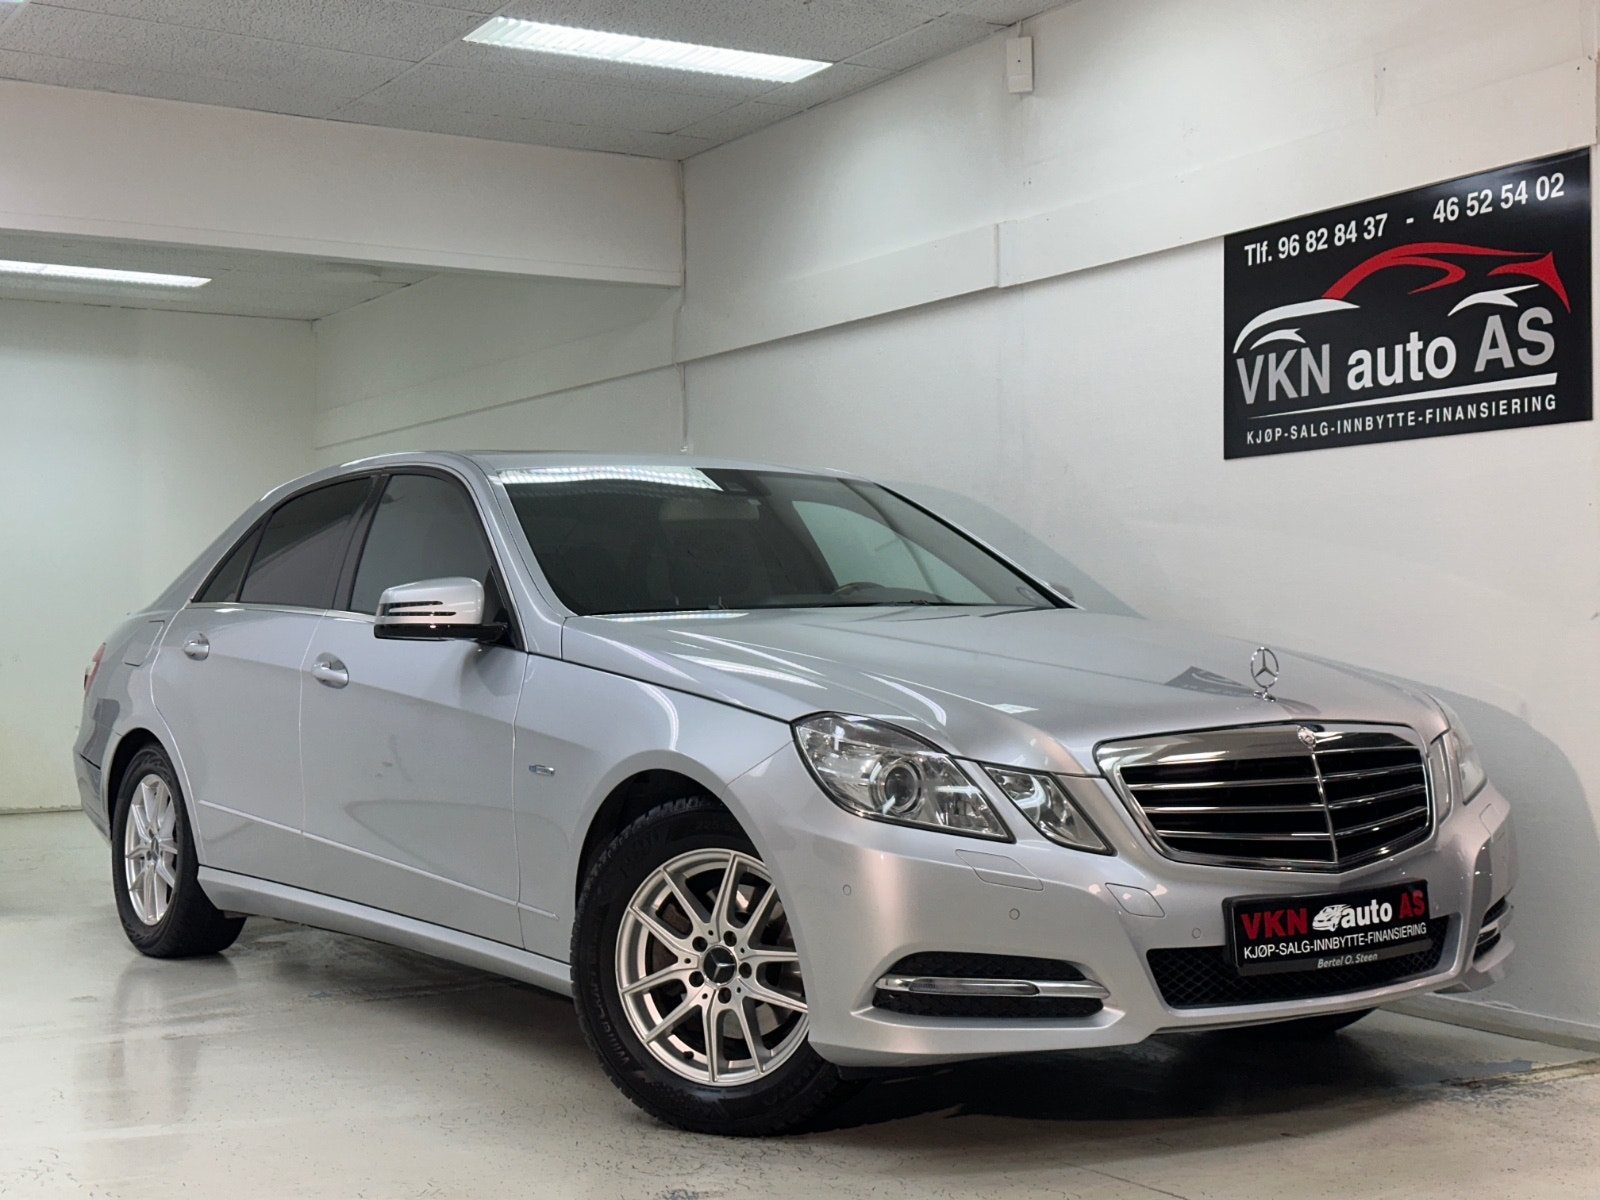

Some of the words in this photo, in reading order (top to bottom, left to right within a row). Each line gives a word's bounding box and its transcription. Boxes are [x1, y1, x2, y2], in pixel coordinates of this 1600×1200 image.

[1244, 240, 1273, 267] Tlf.
[1278, 233, 1300, 259] 96
[1305, 227, 1329, 253] 82
[1334, 220, 1358, 247] 84
[1363, 212, 1388, 240] 37
[1433, 198, 1460, 224] 46
[1466, 189, 1493, 217] 52
[1500, 181, 1528, 210] 54
[1535, 172, 1565, 201] 02
[1236, 343, 1330, 405] VKN
[1347, 331, 1457, 391] auto
[1474, 306, 1555, 373] AS
[1246, 394, 1556, 445] KJØP-SALG-INNBYTTE-FINANSIERING
[1241, 908, 1308, 940] VKN
[1341, 899, 1393, 929] auto
[1398, 890, 1425, 919] AS
[1244, 922, 1427, 960] KJØP-SALG-INNBYTTE-FINANSIERING
[1317, 955, 1344, 969] Bertel
[1344, 954, 1355, 966] O.
[1355, 953, 1378, 964] Steen
